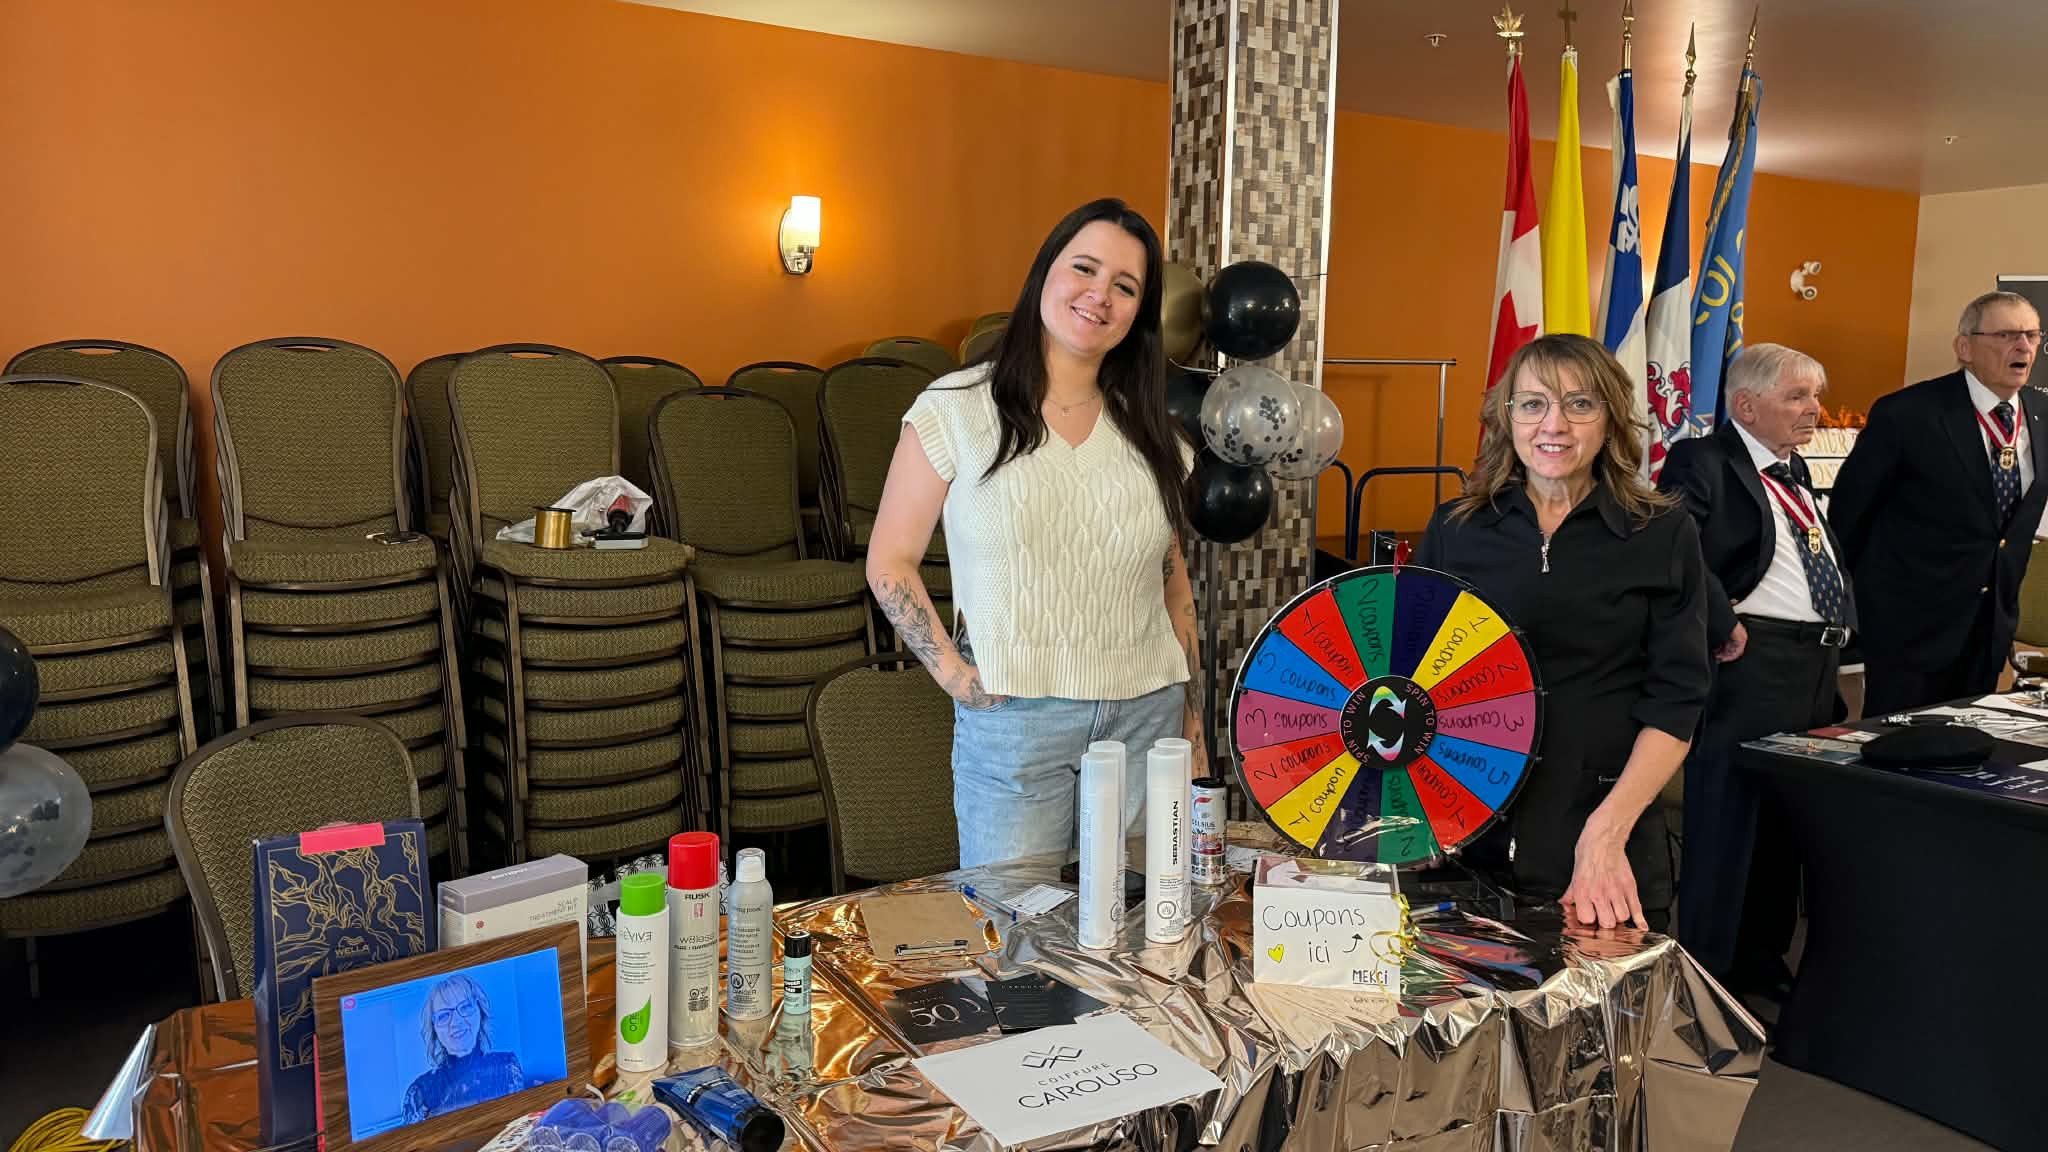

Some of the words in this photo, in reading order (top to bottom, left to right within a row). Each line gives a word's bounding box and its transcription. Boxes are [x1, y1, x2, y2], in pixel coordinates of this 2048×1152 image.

[1279, 667, 1337, 701] coupons
[1406, 683, 1430, 707] SPIN
[1345, 691, 1366, 714] WIN
[1273, 711, 1328, 731] coupons
[1343, 720, 1353, 736] TO
[1425, 709, 1435, 726] TO
[1347, 740, 1370, 764] SPIN
[1414, 732, 1433, 754] WIN
[1308, 767, 1346, 814] coupon
[1171, 799, 1180, 866] SEBASTIAN
[684, 891, 711, 901] RUSK
[1262, 904, 1367, 933] Coupons
[335, 944, 369, 957] WELLA
[1308, 940, 1331, 964] ici
[1017, 1063, 1158, 1109] CAROUSO
[1038, 1062, 1111, 1086] COIFFURE
